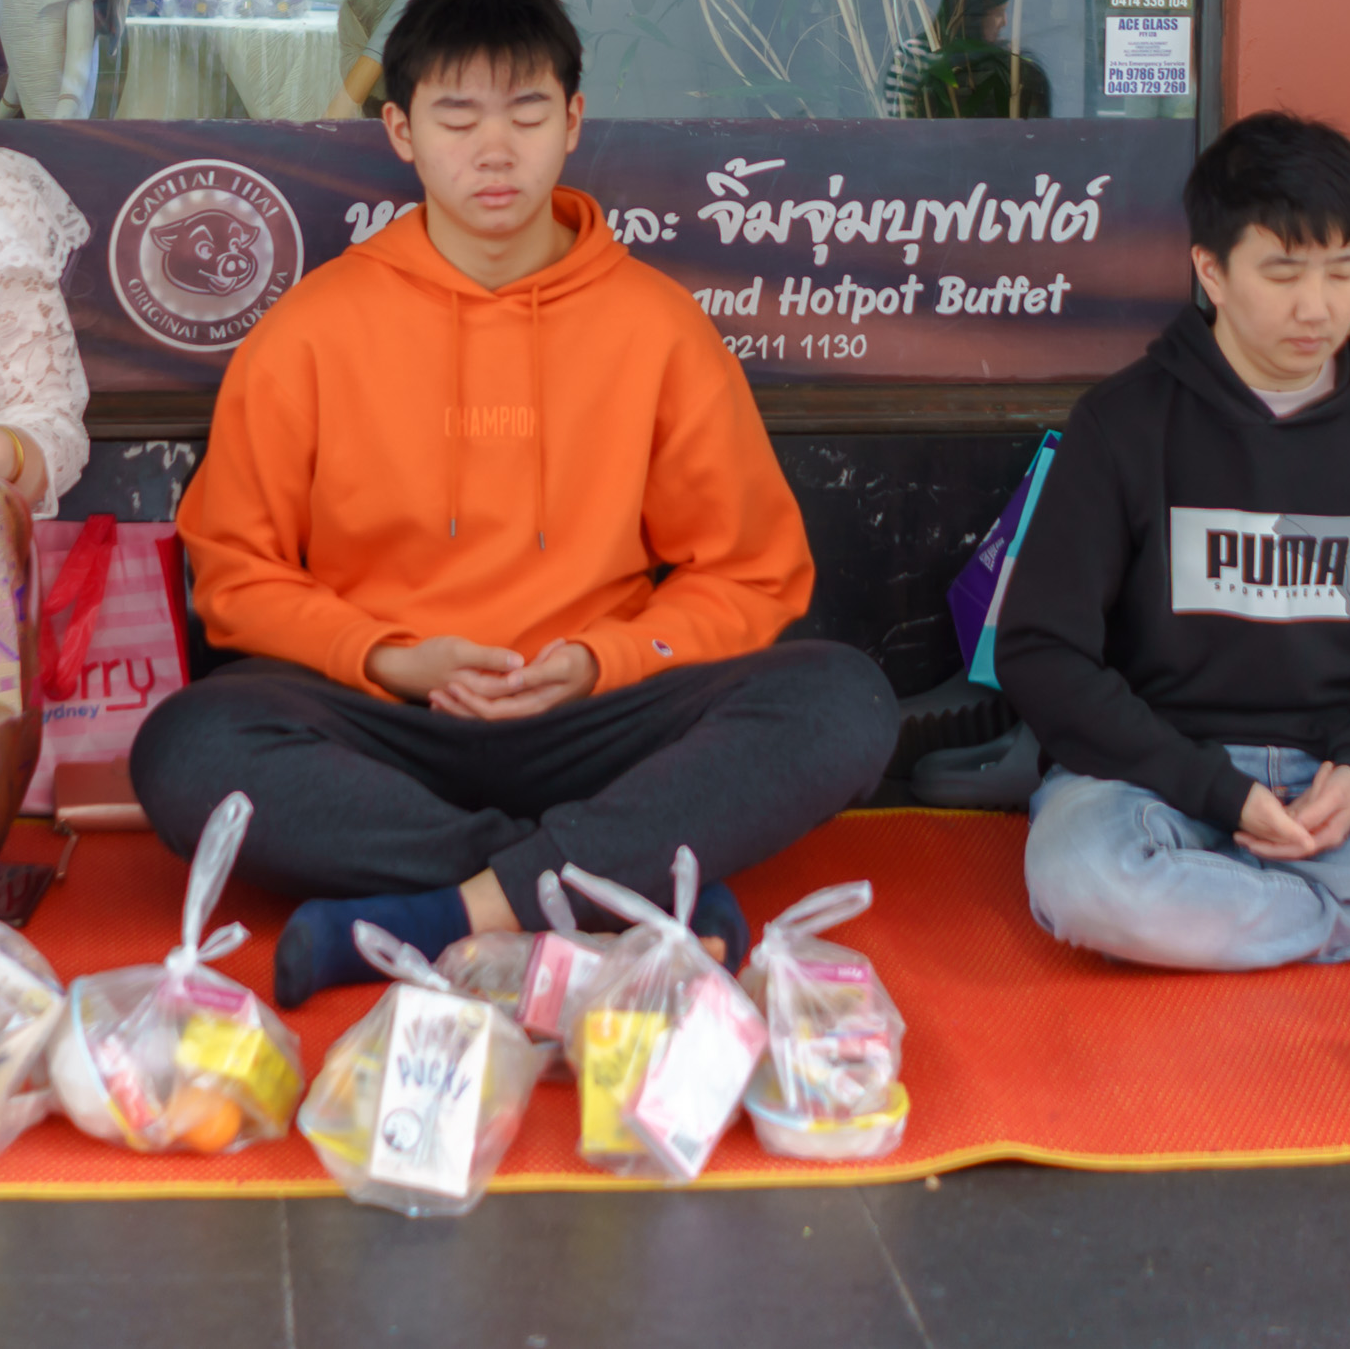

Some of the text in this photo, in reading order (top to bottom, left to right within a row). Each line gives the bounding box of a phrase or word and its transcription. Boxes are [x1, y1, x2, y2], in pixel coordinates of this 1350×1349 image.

[1118, 18, 1178, 31] ACE GLASS
[1108, 81, 1187, 94] 0403 729 260
[1109, 68, 1185, 81] Ph 9786 5708
[130, 171, 281, 226] CAPITAL THAI
[127, 270, 289, 340] ORIGINAL MOOKATA
[691, 272, 1071, 324] and Hotpot Buffet
[799, 332, 868, 360] 1130
[1205, 528, 1350, 587] PUMA
[1214, 581, 1335, 599] SPORTSWEAR
